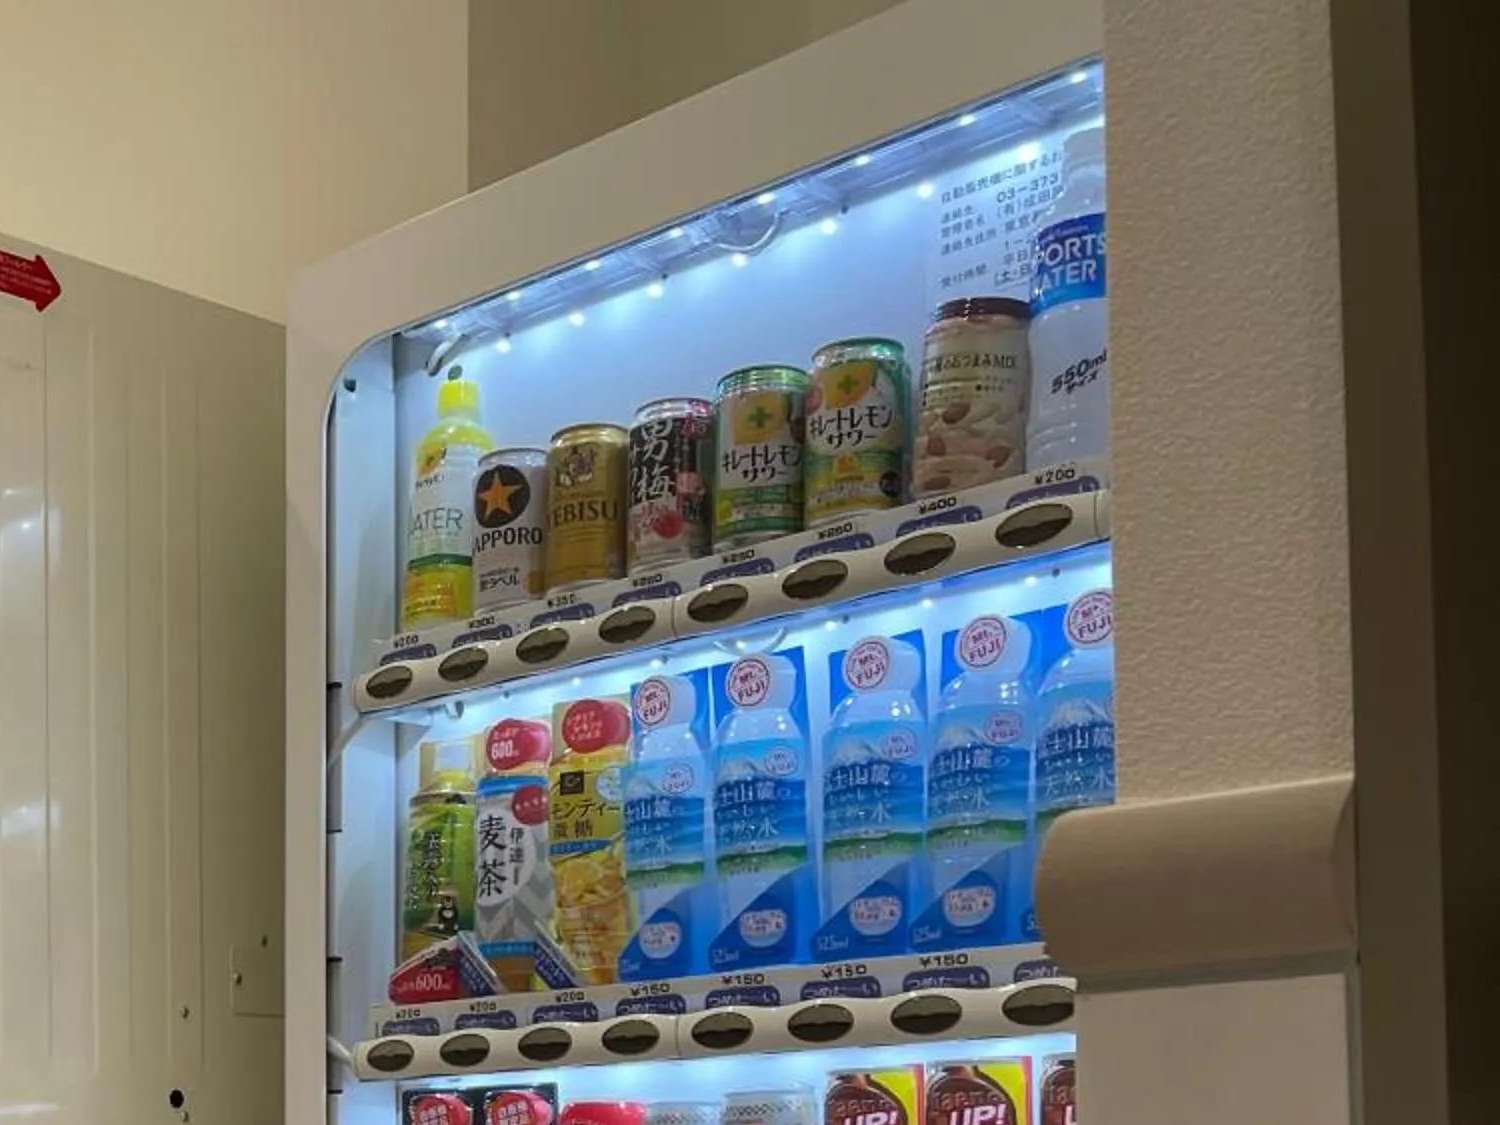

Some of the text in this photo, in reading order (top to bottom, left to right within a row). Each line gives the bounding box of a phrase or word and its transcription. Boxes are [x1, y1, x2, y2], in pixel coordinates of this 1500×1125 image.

[810, 405, 893, 438] キレートレモン
[827, 430, 877, 448] サワー
[743, 466, 788, 482] サワー
[1035, 468, 1076, 484] ¥200
[919, 496, 957, 514] ¥400
[1077, 614, 1112, 639] FUJI
[969, 638, 1002, 661] FUJI
[856, 661, 885, 685] FUJI
[479, 815, 507, 897] 麦茶
[919, 954, 969, 968] ¥150
[721, 973, 765, 985] ¥150
[821, 964, 867, 978] ¥150
[630, 983, 670, 997] ¥150
